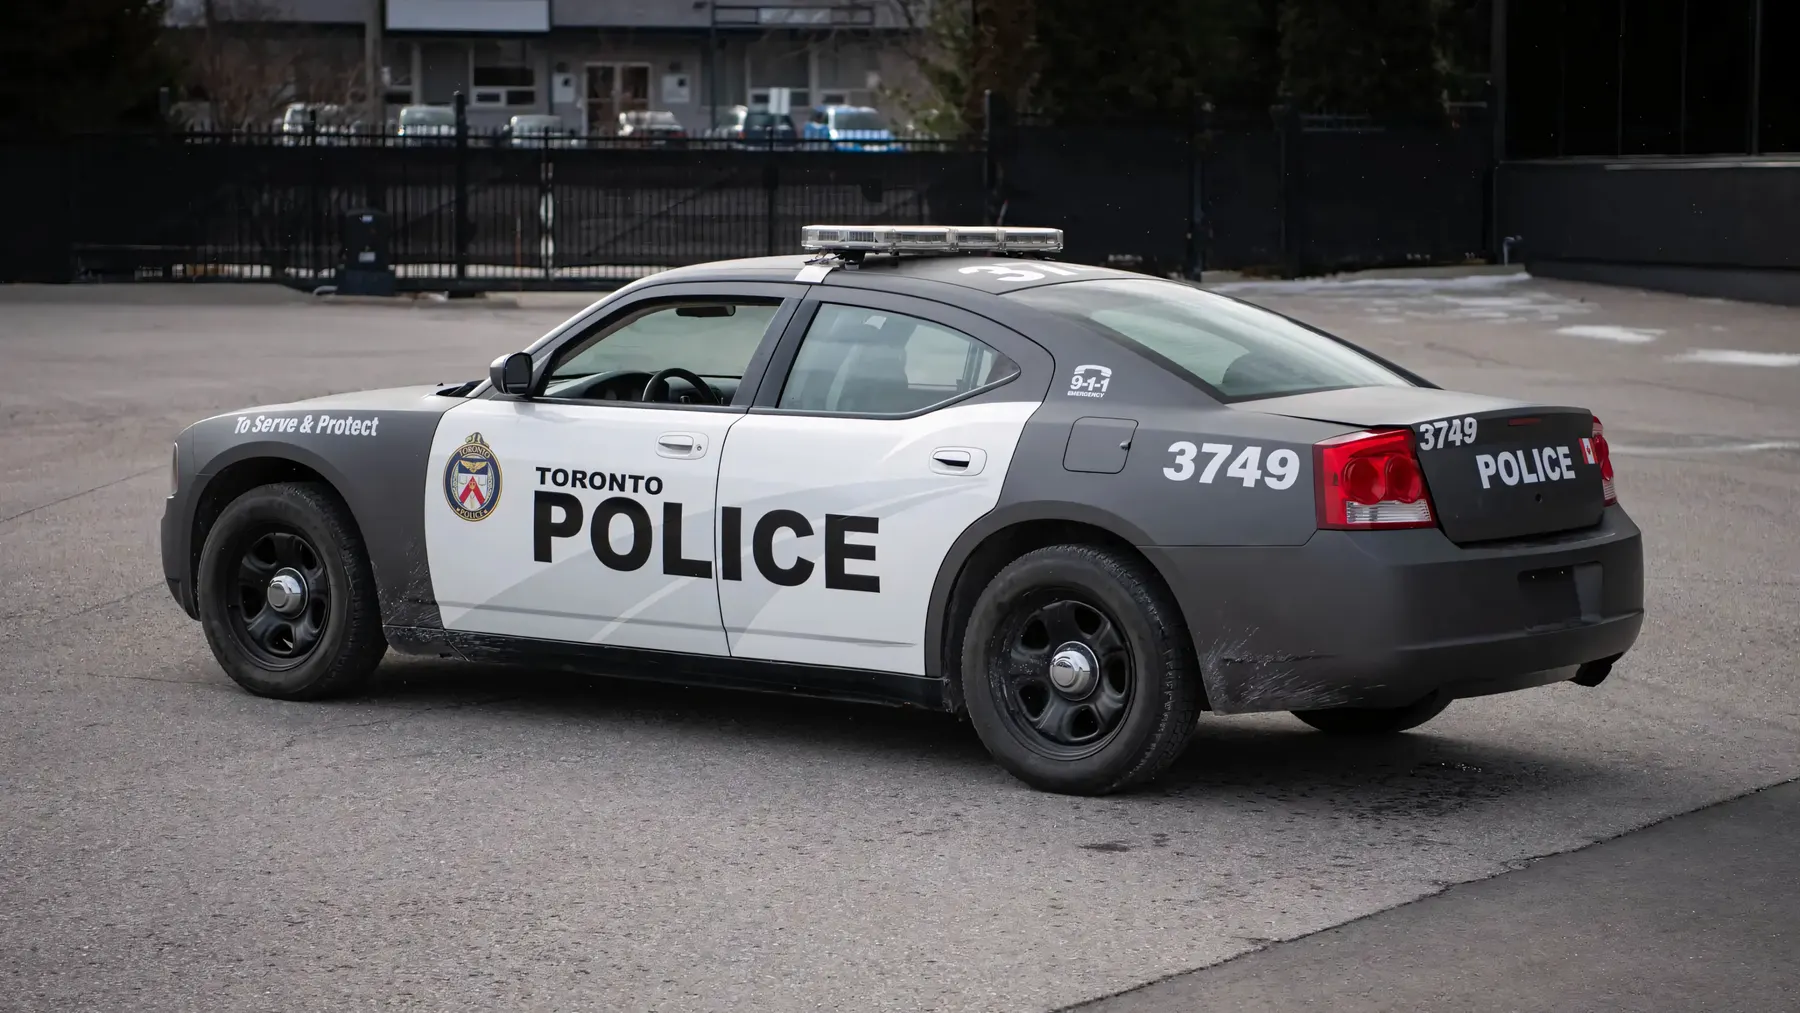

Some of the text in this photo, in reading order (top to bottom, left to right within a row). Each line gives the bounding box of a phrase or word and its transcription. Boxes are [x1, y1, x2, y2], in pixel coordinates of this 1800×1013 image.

[1067, 390, 1105, 398] EMERGENCY
[1070, 375, 1110, 392] 9-1-1
[234, 414, 379, 436] To Serve & Protect
[1419, 416, 1477, 451] 3749
[459, 445, 491, 459] TORONTO
[1162, 440, 1300, 490] 3749
[1475, 446, 1576, 489] POLICE
[535, 466, 664, 496] TORONTO
[460, 507, 484, 519] POLICE
[533, 489, 881, 594] POLICE
